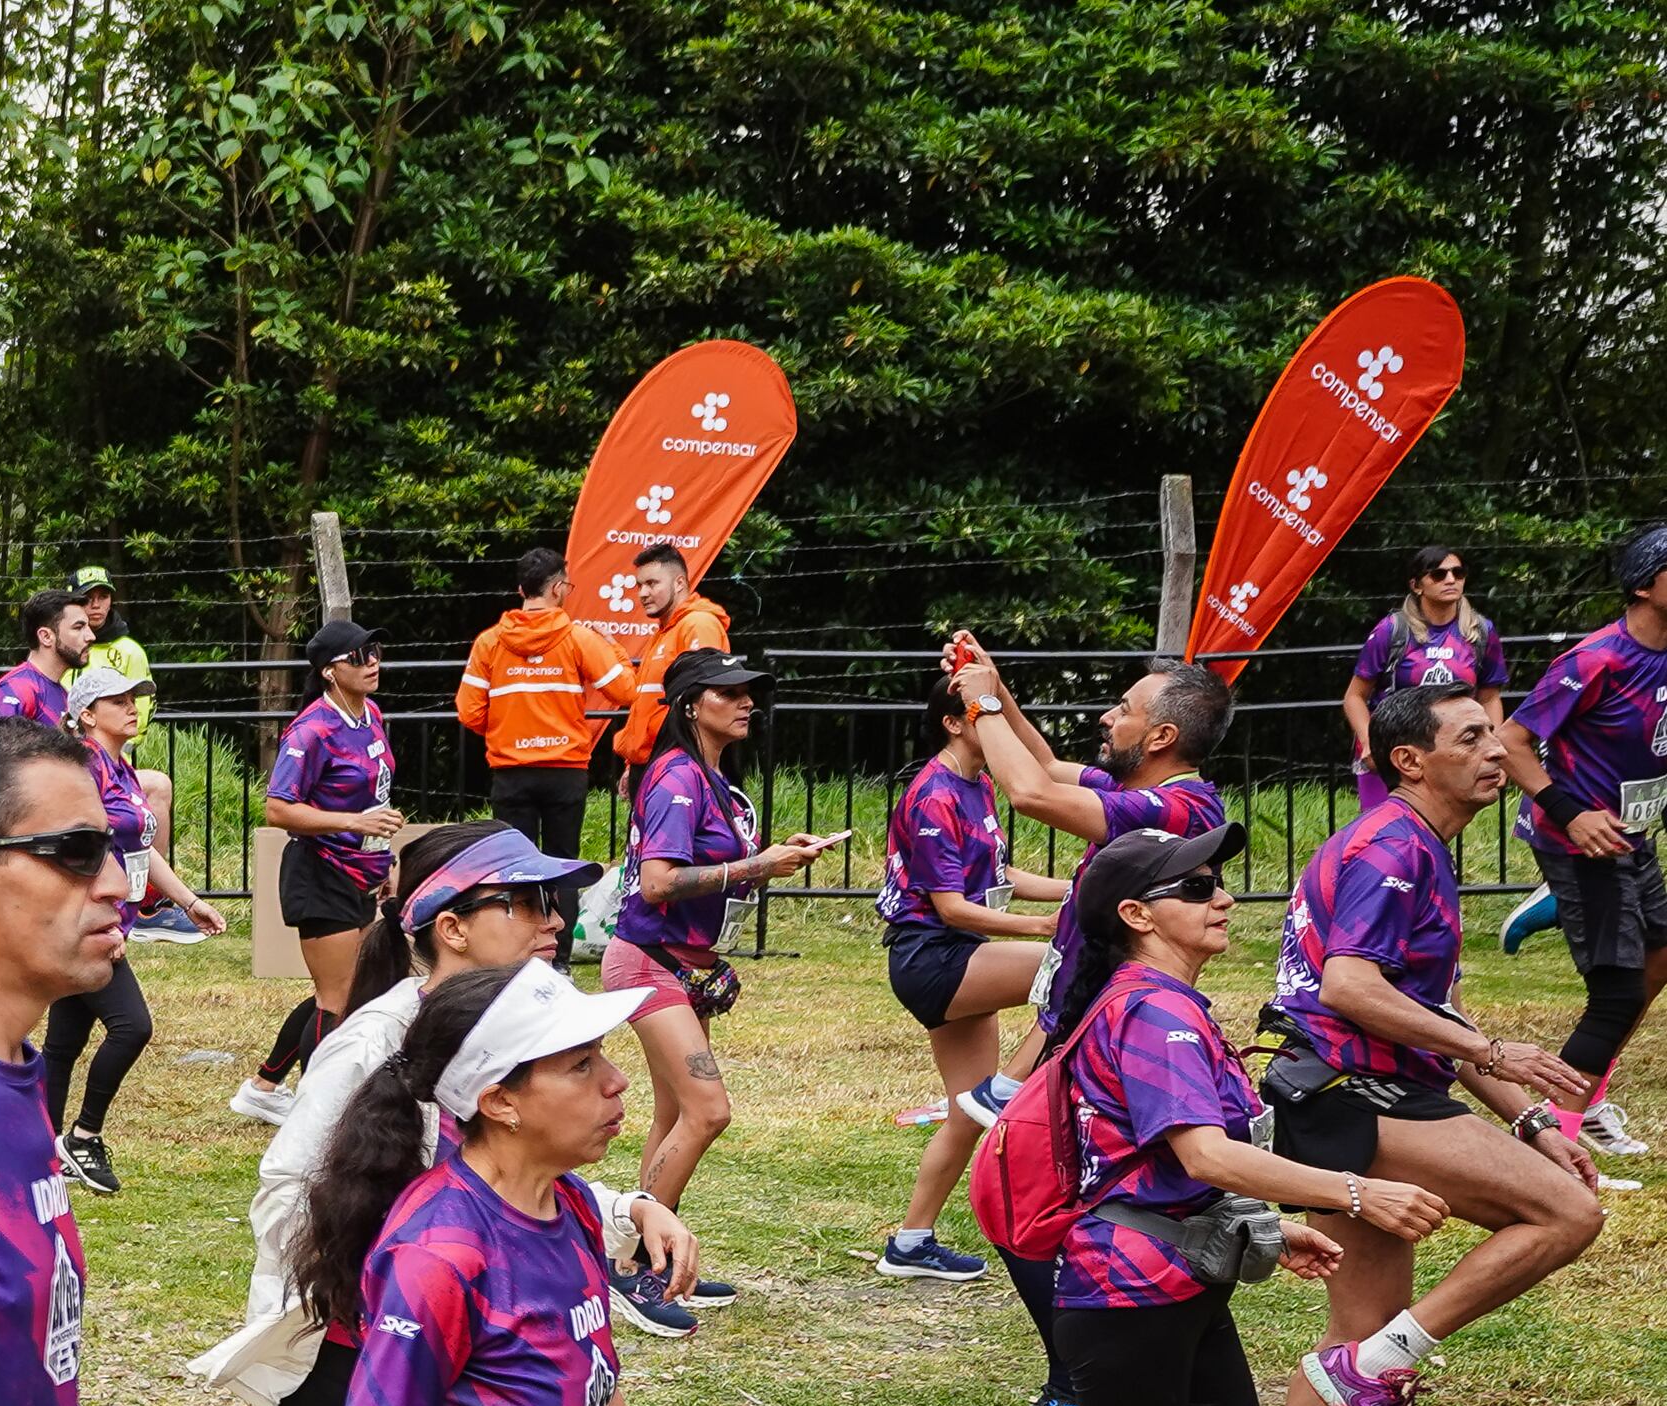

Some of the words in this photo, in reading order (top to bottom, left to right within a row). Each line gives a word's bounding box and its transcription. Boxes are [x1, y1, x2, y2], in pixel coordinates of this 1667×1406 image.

[1310, 362, 1403, 445] compensar
[662, 437, 757, 457] compensar
[1248, 481, 1326, 548] compensar
[607, 529, 701, 549] compensar
[1207, 592, 1258, 637] compensar
[507, 666, 563, 676] compensar
[570, 1295, 605, 1341] IDRD
